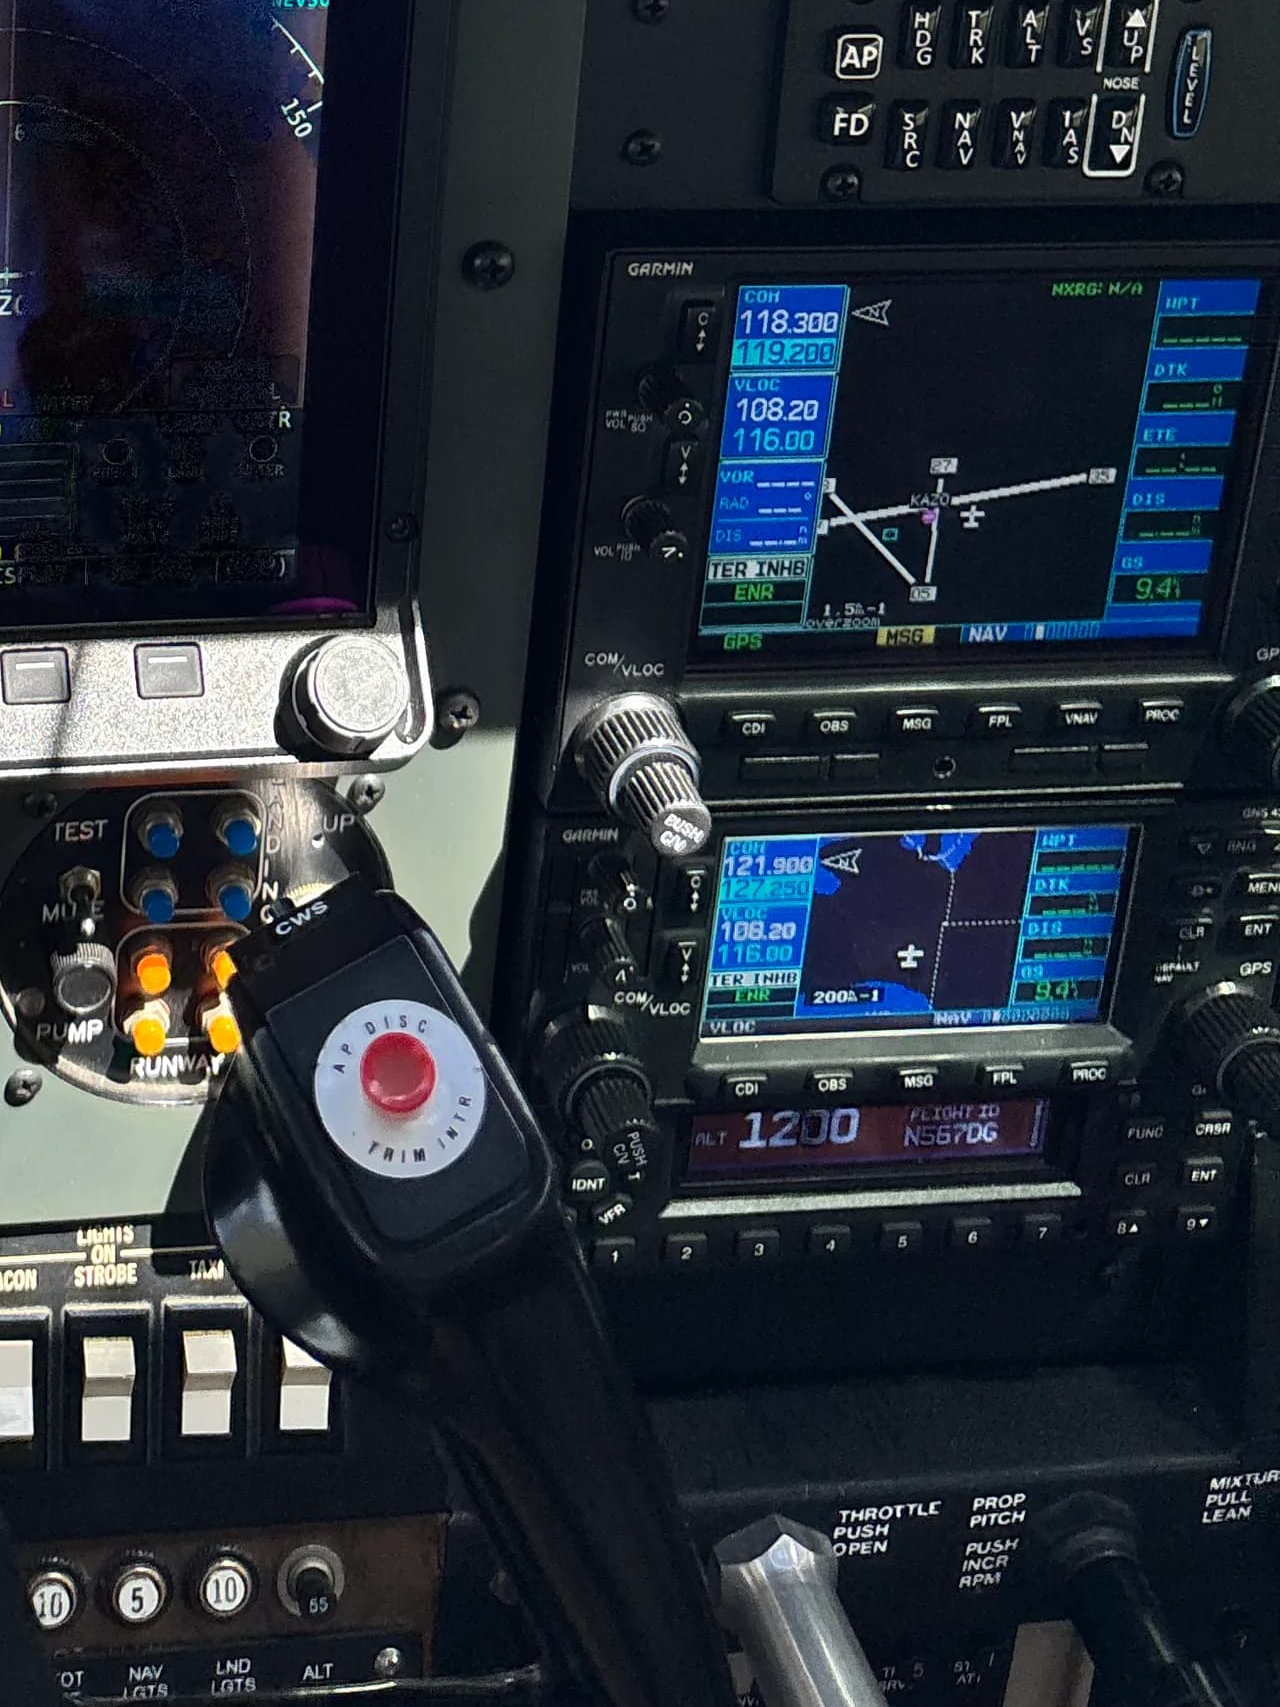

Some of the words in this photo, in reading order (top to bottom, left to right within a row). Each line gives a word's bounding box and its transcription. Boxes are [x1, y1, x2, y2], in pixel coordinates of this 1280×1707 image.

[840, 46, 878, 69] AP
[1103, 77, 1140, 90] NOSE
[833, 113, 869, 136] FD
[627, 262, 694, 277] GARMIN
[739, 310, 838, 334] 118.300
[736, 340, 834, 364] 119.200
[736, 398, 819, 422] 108.20
[733, 428, 814, 451] 116.00
[710, 560, 747, 578] TER
[734, 584, 774, 601] ENR
[723, 633, 763, 651] GPS
[886, 628, 924, 645] MSG
[968, 626, 1007, 644] NAV
[742, 721, 765, 734] CDI
[820, 719, 848, 733] OBS
[54, 819, 109, 841] TEST
[323, 815, 355, 834] UP
[725, 856, 813, 877] 121.900
[275, 900, 329, 936] CWS
[1240, 962, 1272, 976] GPS
[36, 1020, 103, 1043] PUMP
[365, 1014, 427, 1034] DISC
[739, 1109, 860, 1149] 1200
[598, 1204, 626, 1225] VFR
[77, 1225, 134, 1247] LIGHTS
[91, 1245, 116, 1263] ON
[74, 1262, 138, 1288] STROBE
[972, 1492, 1026, 1511] PROP
[1205, 1490, 1252, 1508] PULL
[838, 1500, 942, 1523] THROTTLE
[968, 1509, 1026, 1529] PITCH
[1201, 1505, 1252, 1524] LEAN
[832, 1523, 889, 1541] PUSH
[832, 1540, 887, 1558] OPEN
[965, 1537, 1019, 1557] PUSH
[962, 1554, 1009, 1572] INCR
[958, 1571, 1001, 1590] RPM
[212, 1577, 237, 1604] 10
[128, 1664, 163, 1682] NAV
[216, 1658, 251, 1676] LND
[303, 1663, 333, 1680] ALT
